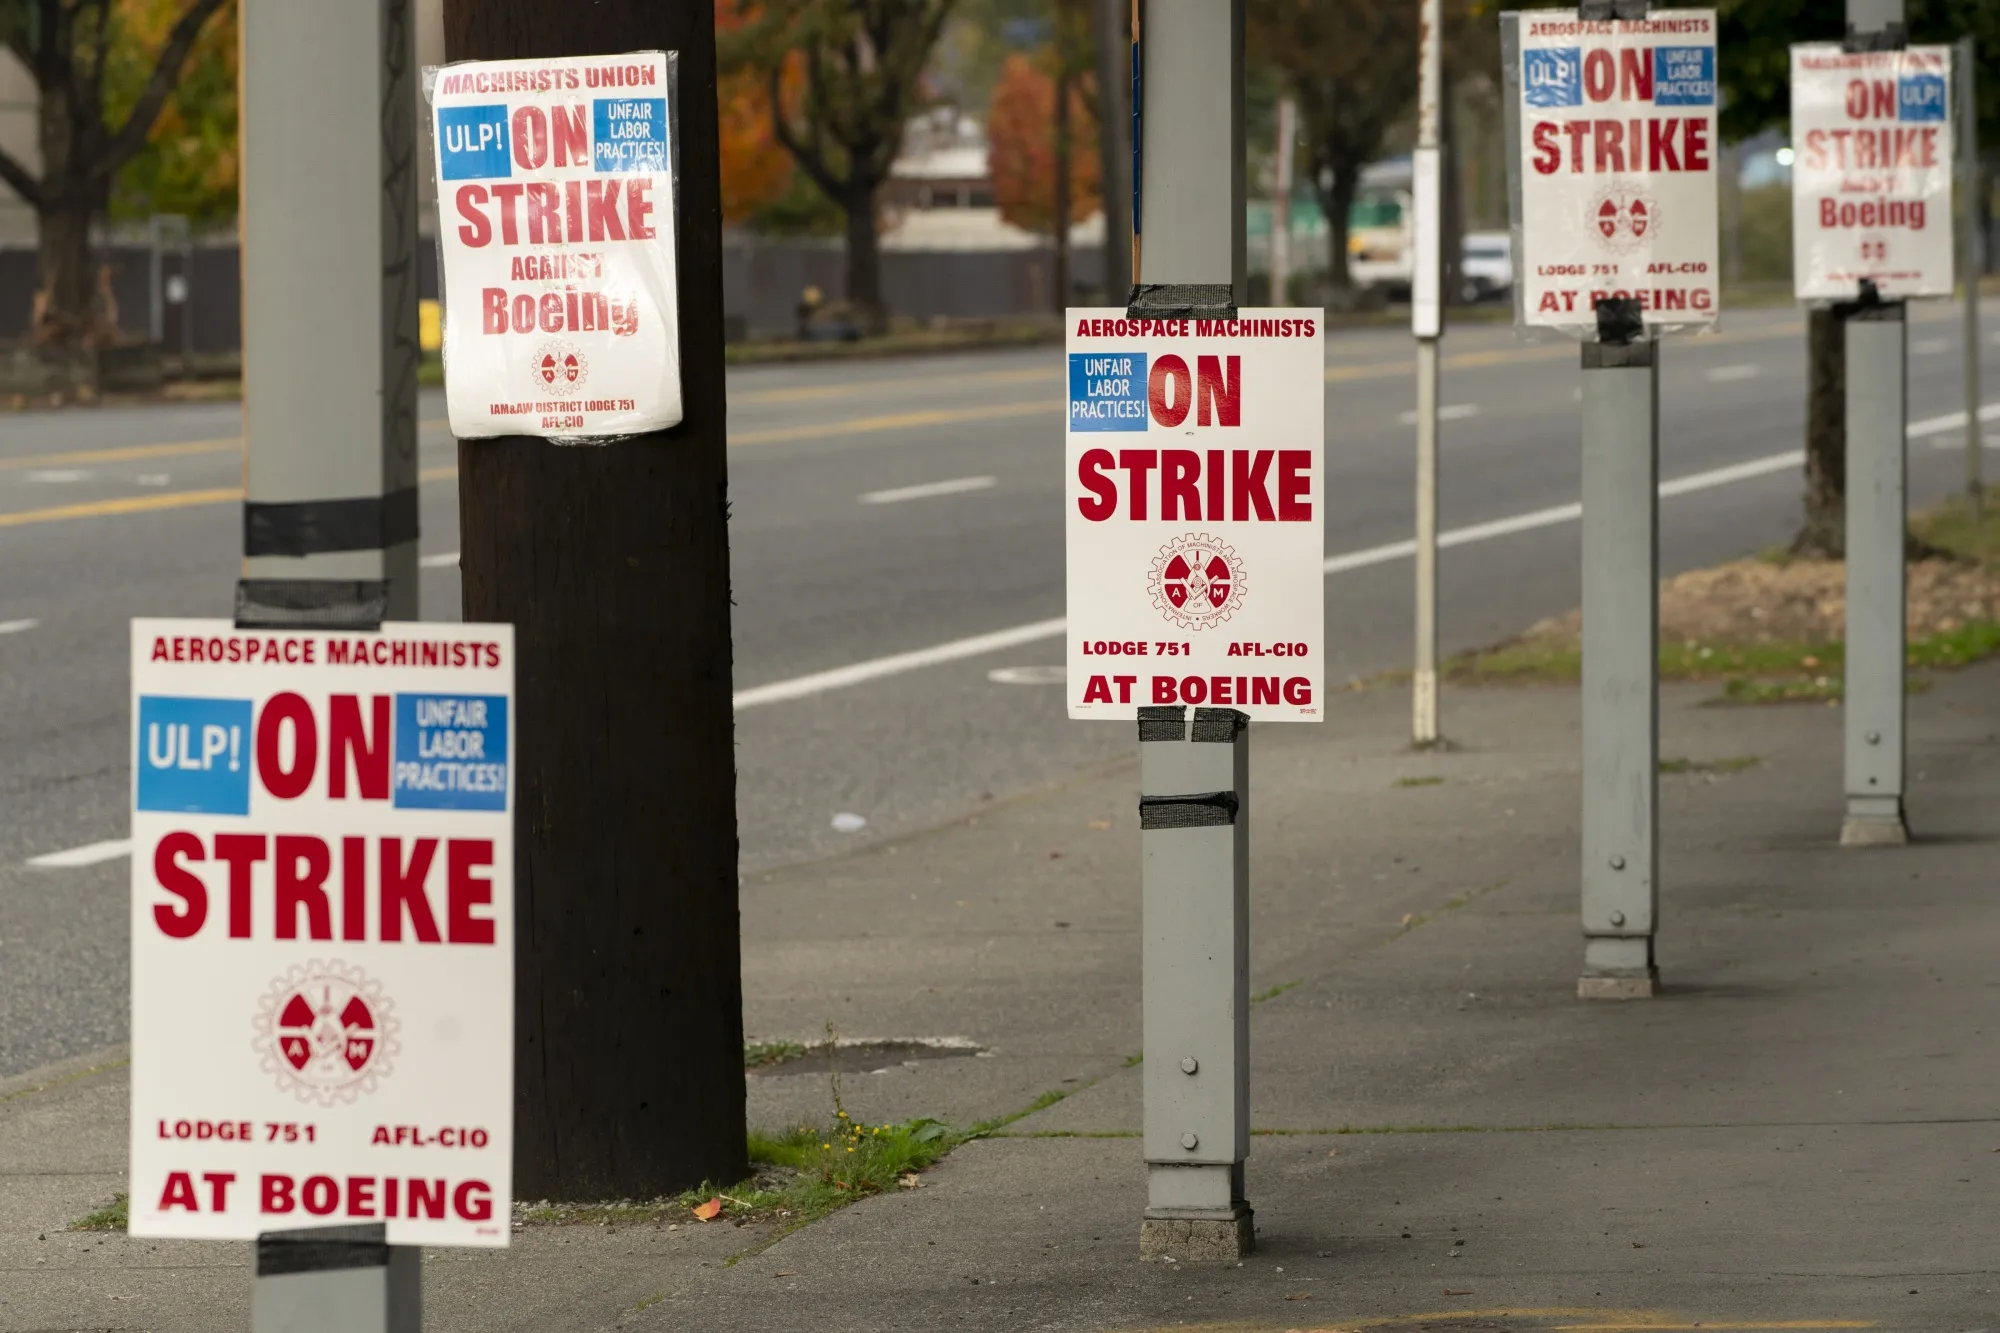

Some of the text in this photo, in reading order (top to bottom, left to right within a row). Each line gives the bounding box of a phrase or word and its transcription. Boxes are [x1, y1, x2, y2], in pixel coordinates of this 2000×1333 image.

[1530, 19, 1710, 36] AEROSPACE MACHINISTS
[443, 65, 656, 95] MACHINISTS UNION
[1529, 59, 1577, 88] ULP!
[1584, 47, 1653, 103] ON
[608, 103, 653, 120] UNFAIR
[1846, 78, 1896, 120] ON
[446, 122, 503, 153] ULP!
[512, 104, 588, 170] ON
[611, 121, 651, 139] LABOR
[596, 142, 665, 159] PRACTICES!
[1532, 117, 1710, 175] STRIKE
[1806, 127, 1938, 169] STRIKE
[455, 178, 656, 248] STRIKE
[1819, 196, 1926, 230] Boeing
[1537, 264, 1619, 276] LODGE 751
[1646, 262, 1708, 274] AFL-CIO
[482, 285, 639, 336] Boeing
[1538, 290, 1578, 312] AT
[1077, 319, 1315, 338] AEROSPACE MACHINISTS
[1085, 358, 1132, 376] UNFAIR
[1087, 379, 1130, 397] LABOR
[1148, 354, 1241, 427] ON
[490, 399, 635, 415] IAM&AW DISTRICT LODGE 751
[542, 415, 584, 428] AFL-CIO
[1072, 400, 1145, 419] PRACTICES!
[1078, 448, 1312, 522] STRIKE
[1177, 543, 1186, 551] OF
[1187, 541, 1224, 554] MACHINISTS
[1223, 554, 1233, 566] AND
[1156, 549, 1178, 586] ASSOCIATION
[1172, 587, 1223, 598] A M
[1228, 567, 1239, 604] AEROSPACE
[1201, 604, 1231, 621] WORKERS
[152, 637, 502, 668] AEROSPACE MACHINISTS
[1083, 641, 1190, 656] LODGE 751
[1227, 642, 1308, 657] AFL-CIO
[1083, 675, 1312, 706] AT BOEING
[416, 699, 487, 728] UNFAIR
[149, 723, 241, 772] ULP!
[256, 691, 391, 800] ON
[418, 730, 485, 759] LABOR
[395, 761, 506, 792] PRACTICES!
[153, 831, 495, 945] STRIKE
[158, 1120, 316, 1143] LODGE 751
[371, 1126, 489, 1149] AFL-CIO
[158, 1172, 492, 1222] AT BOEING
